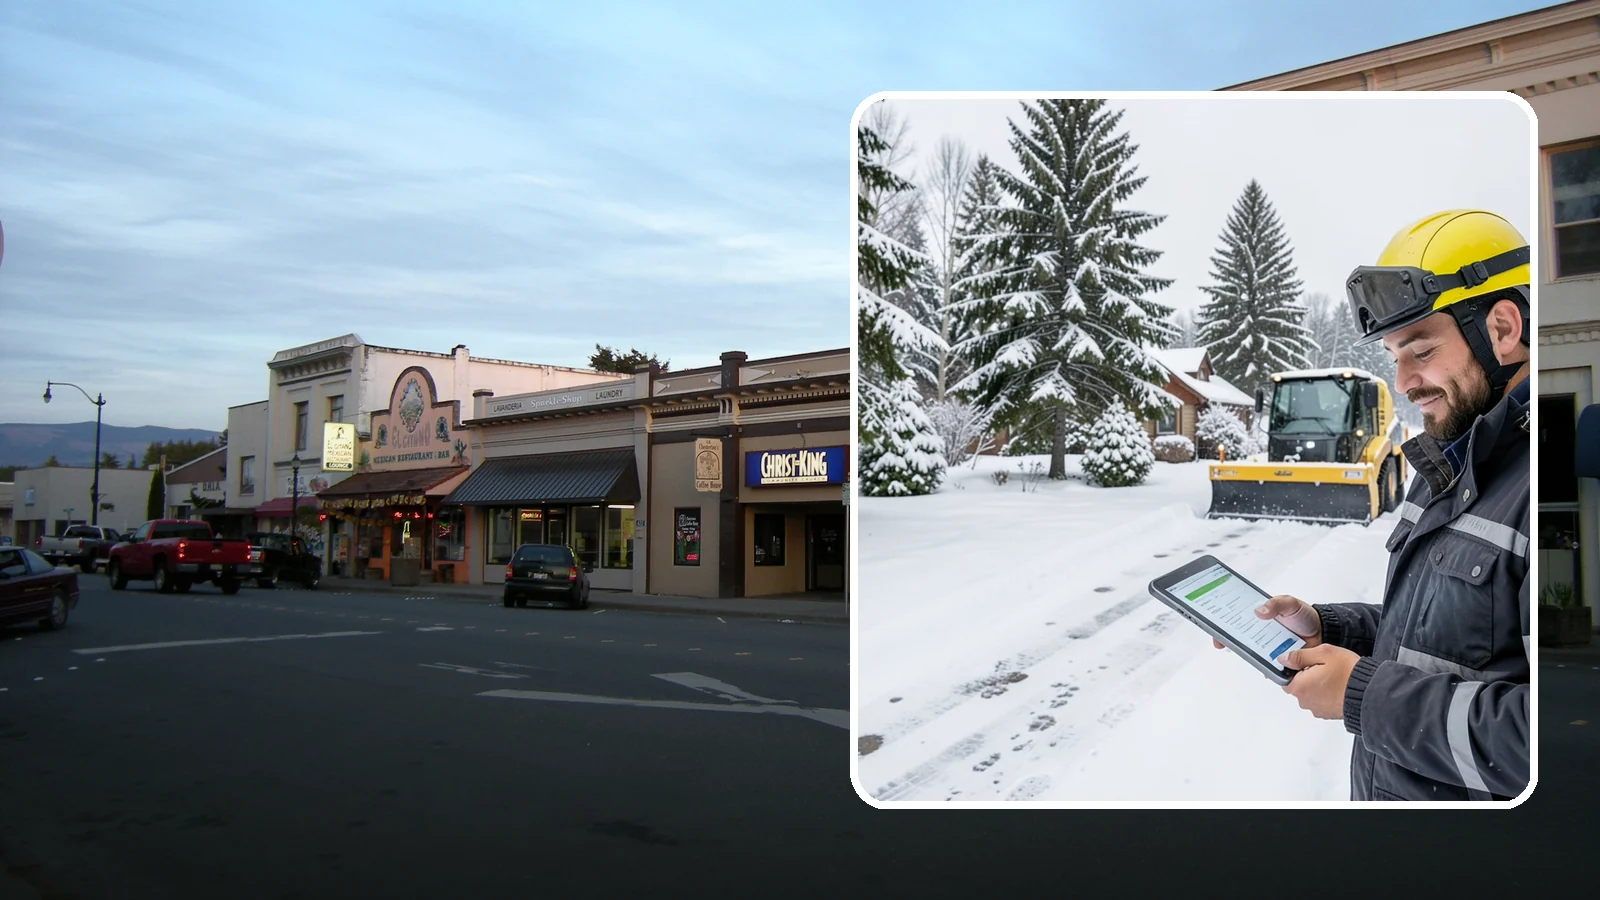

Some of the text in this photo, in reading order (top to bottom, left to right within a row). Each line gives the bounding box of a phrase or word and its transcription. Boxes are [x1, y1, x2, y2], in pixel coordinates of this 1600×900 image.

[493, 402, 523, 412] LAVANDERIA
[561, 395, 582, 405] Shop
[595, 389, 624, 400] LAUNDRY
[374, 455, 396, 464] MEXICAN
[398, 452, 433, 462] RESTAURANT
[438, 450, 450, 459] BAR
[761, 450, 827, 478] CHRIST KING
